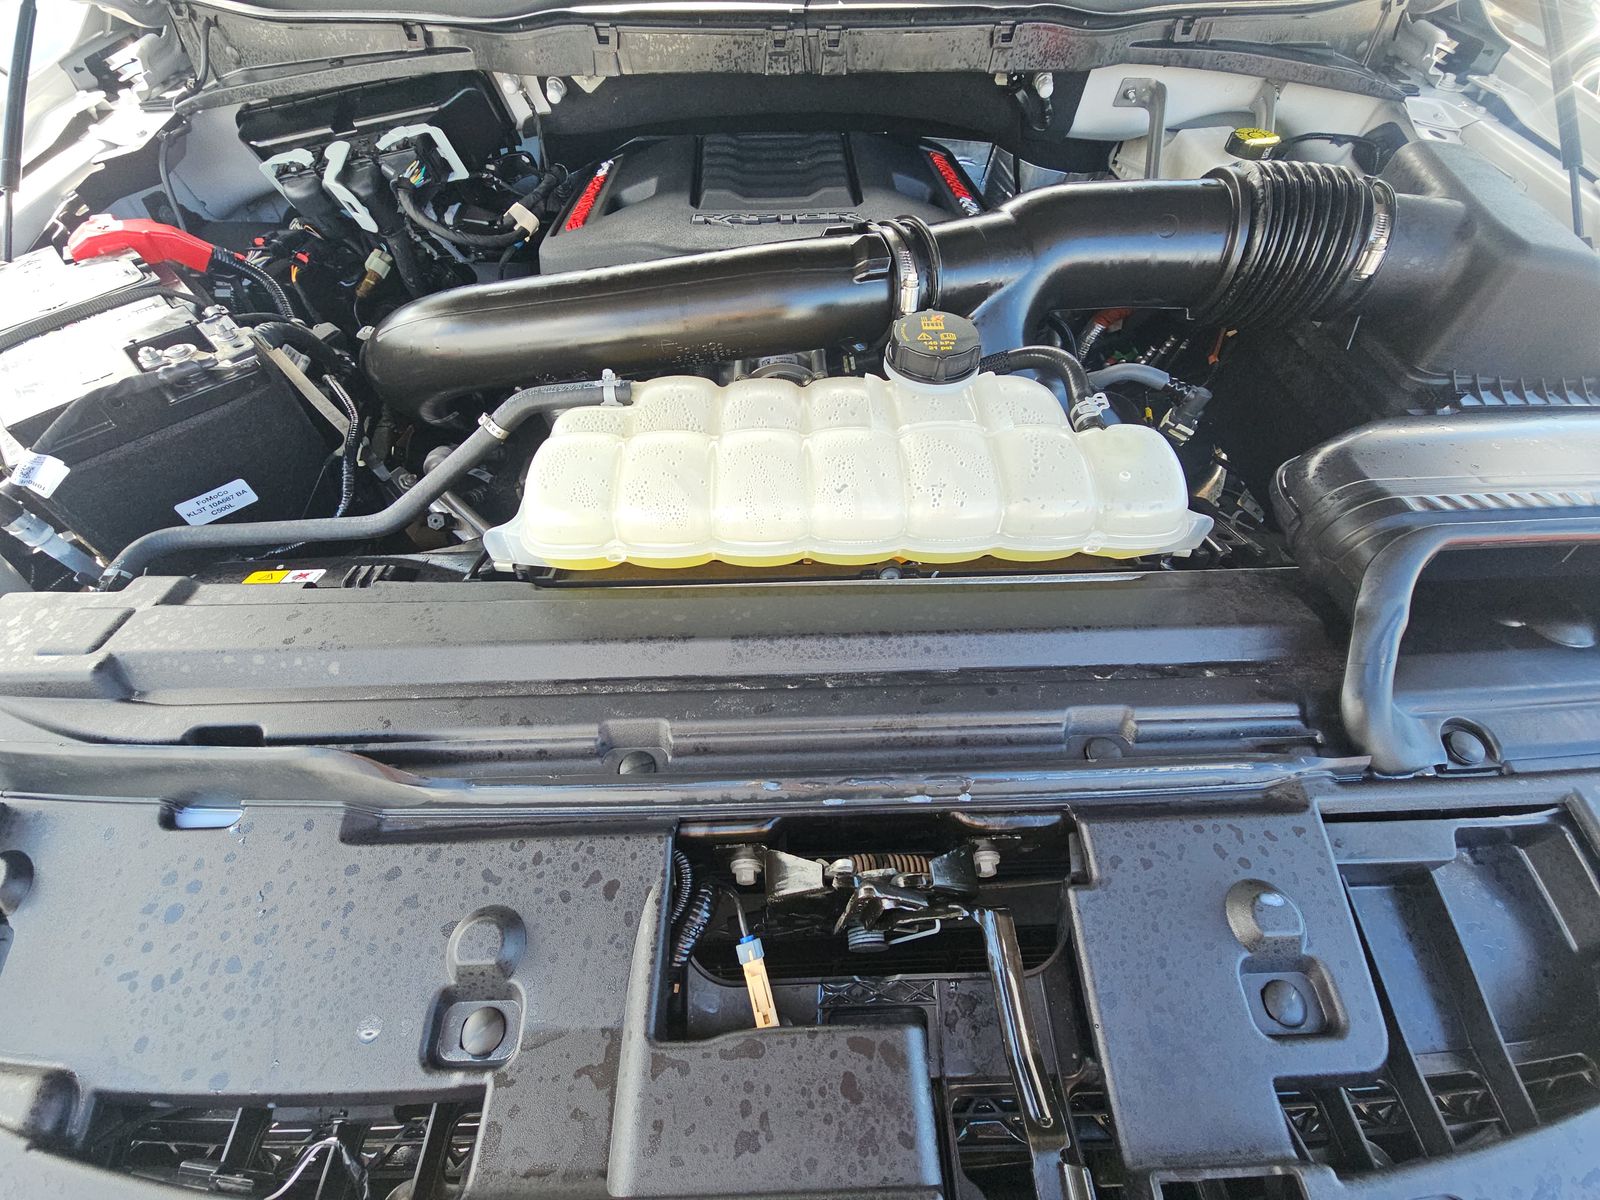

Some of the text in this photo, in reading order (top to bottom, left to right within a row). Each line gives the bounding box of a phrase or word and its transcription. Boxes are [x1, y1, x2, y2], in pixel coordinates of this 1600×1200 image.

[186, 506, 207, 518] KL3T
[235, 489, 248, 497] BA
[196, 490, 229, 506] FoMoCo
[210, 503, 236, 516] C500L
